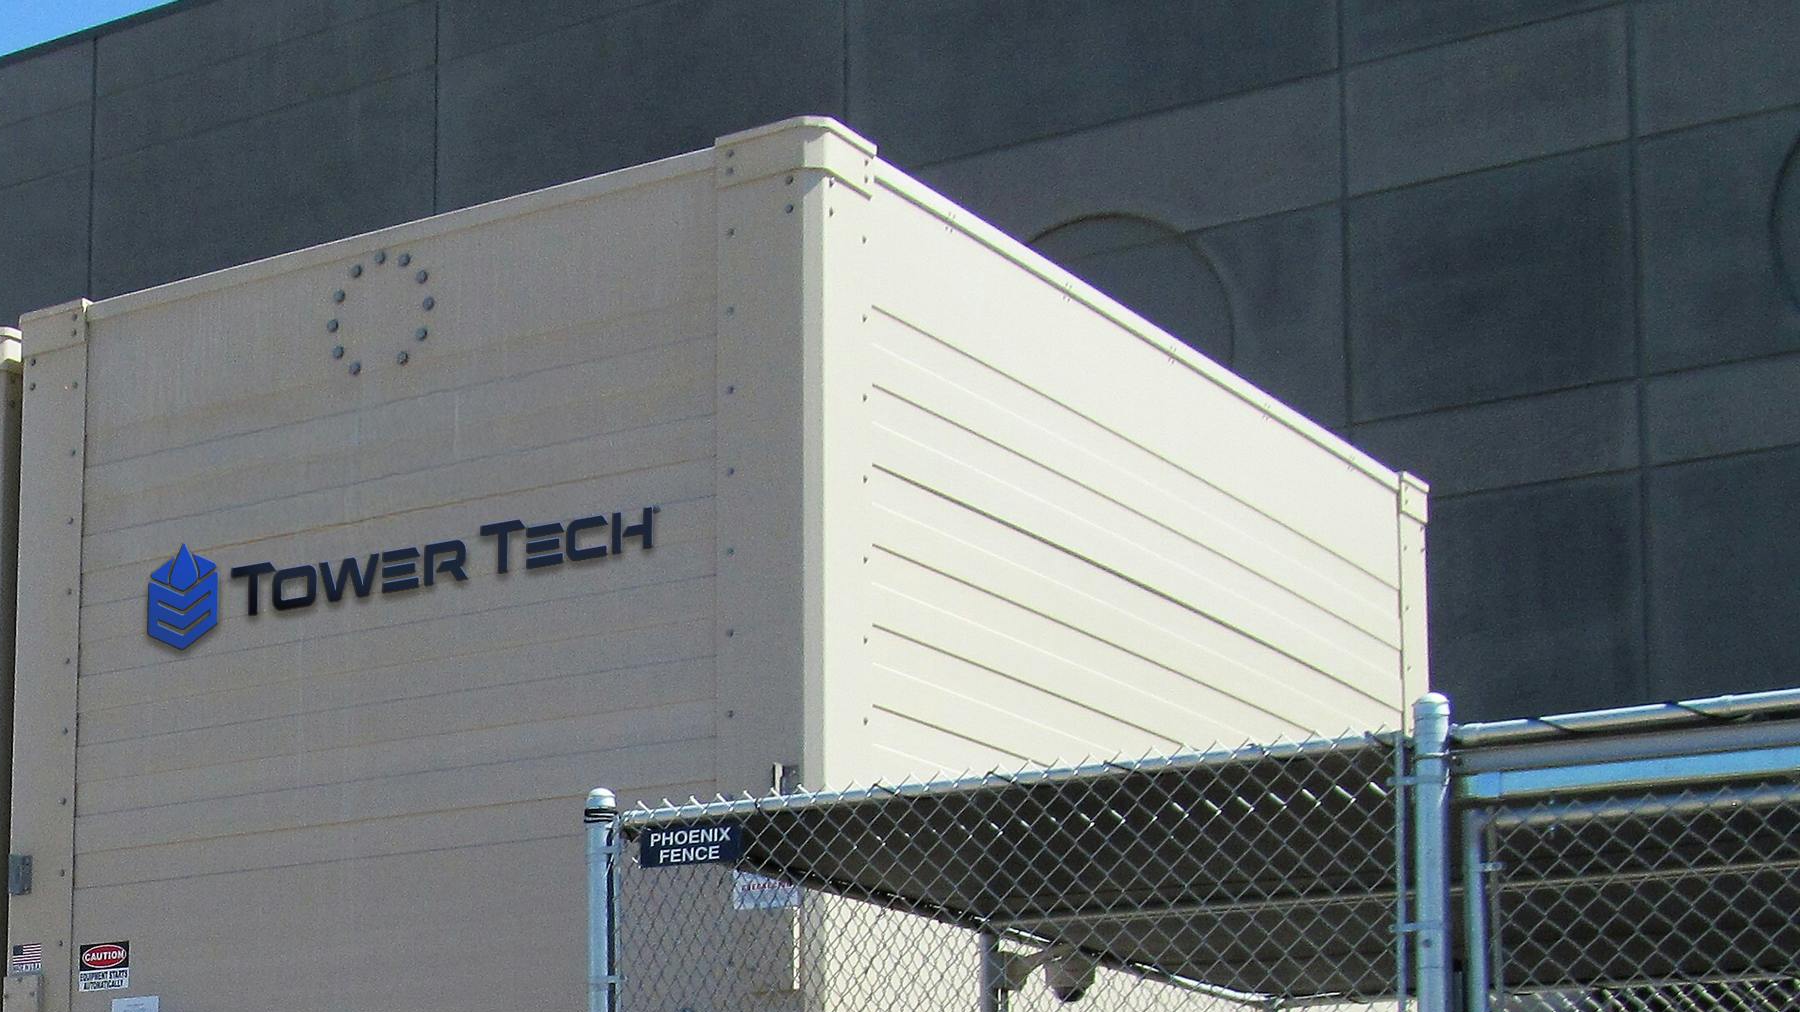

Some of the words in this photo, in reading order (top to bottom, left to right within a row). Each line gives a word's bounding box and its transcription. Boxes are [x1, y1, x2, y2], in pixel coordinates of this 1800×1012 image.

[230, 538, 469, 617] TOWER
[479, 506, 655, 575] TECH
[650, 826, 732, 847] PHOENIX
[659, 845, 720, 864] FENCE
[84, 950, 124, 962] CAUTION
